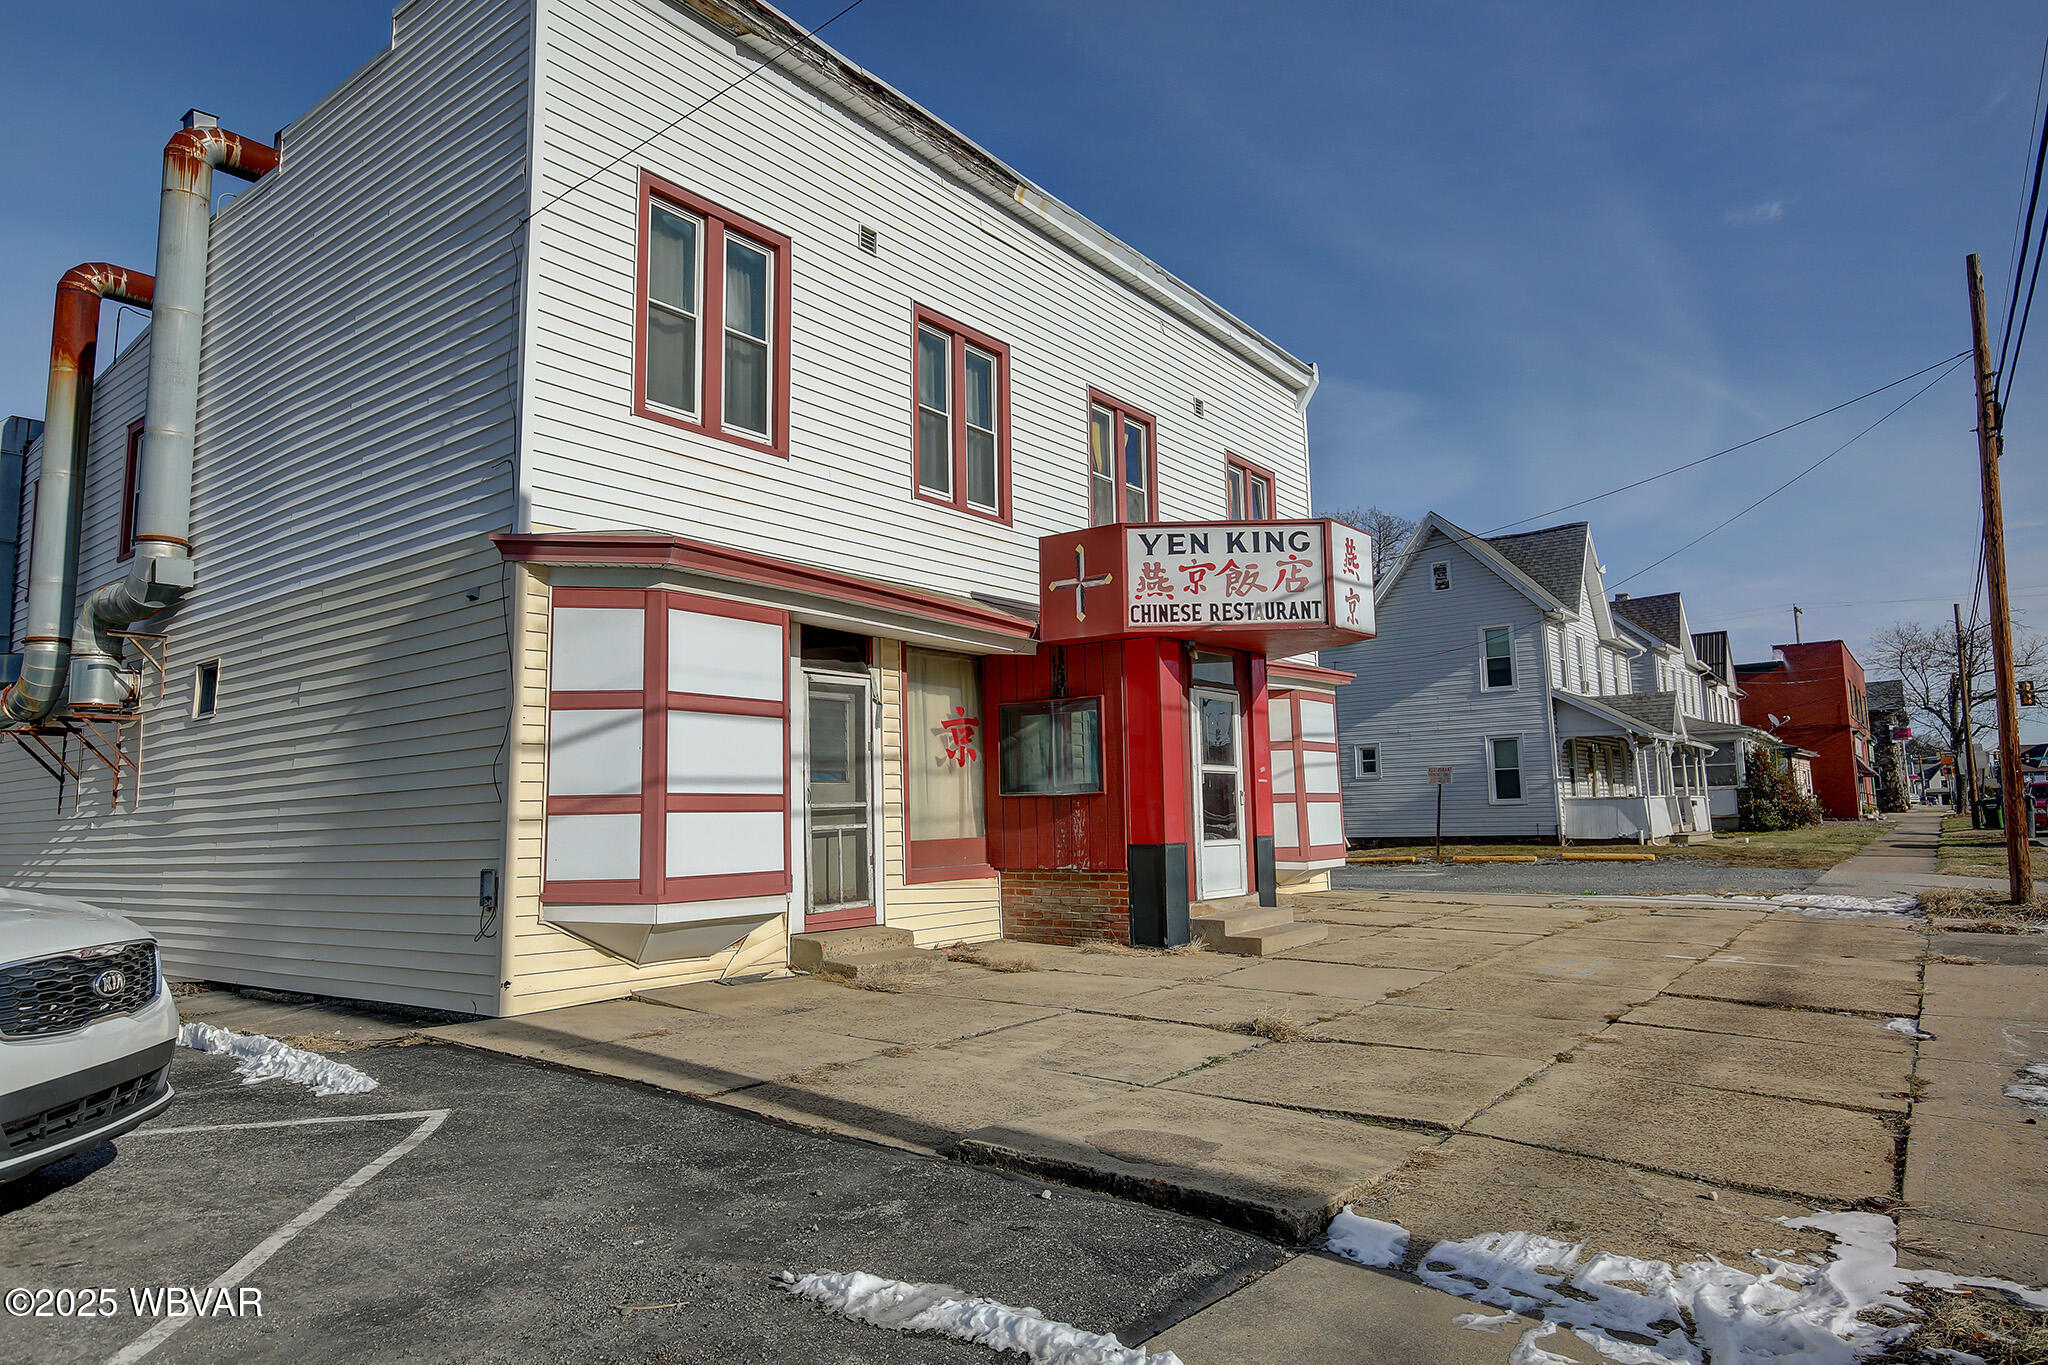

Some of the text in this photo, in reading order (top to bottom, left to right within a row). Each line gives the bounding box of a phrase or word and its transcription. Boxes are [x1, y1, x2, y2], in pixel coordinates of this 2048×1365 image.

[1138, 531, 1311, 556] YEN KING
[1135, 554, 1313, 600] 燕京飯店
[1343, 537, 1360, 624] 燕京
[1130, 601, 1322, 623] CHINESE RESTAURANT
[941, 706, 979, 767] 京
[102, 974, 123, 992] KIA
